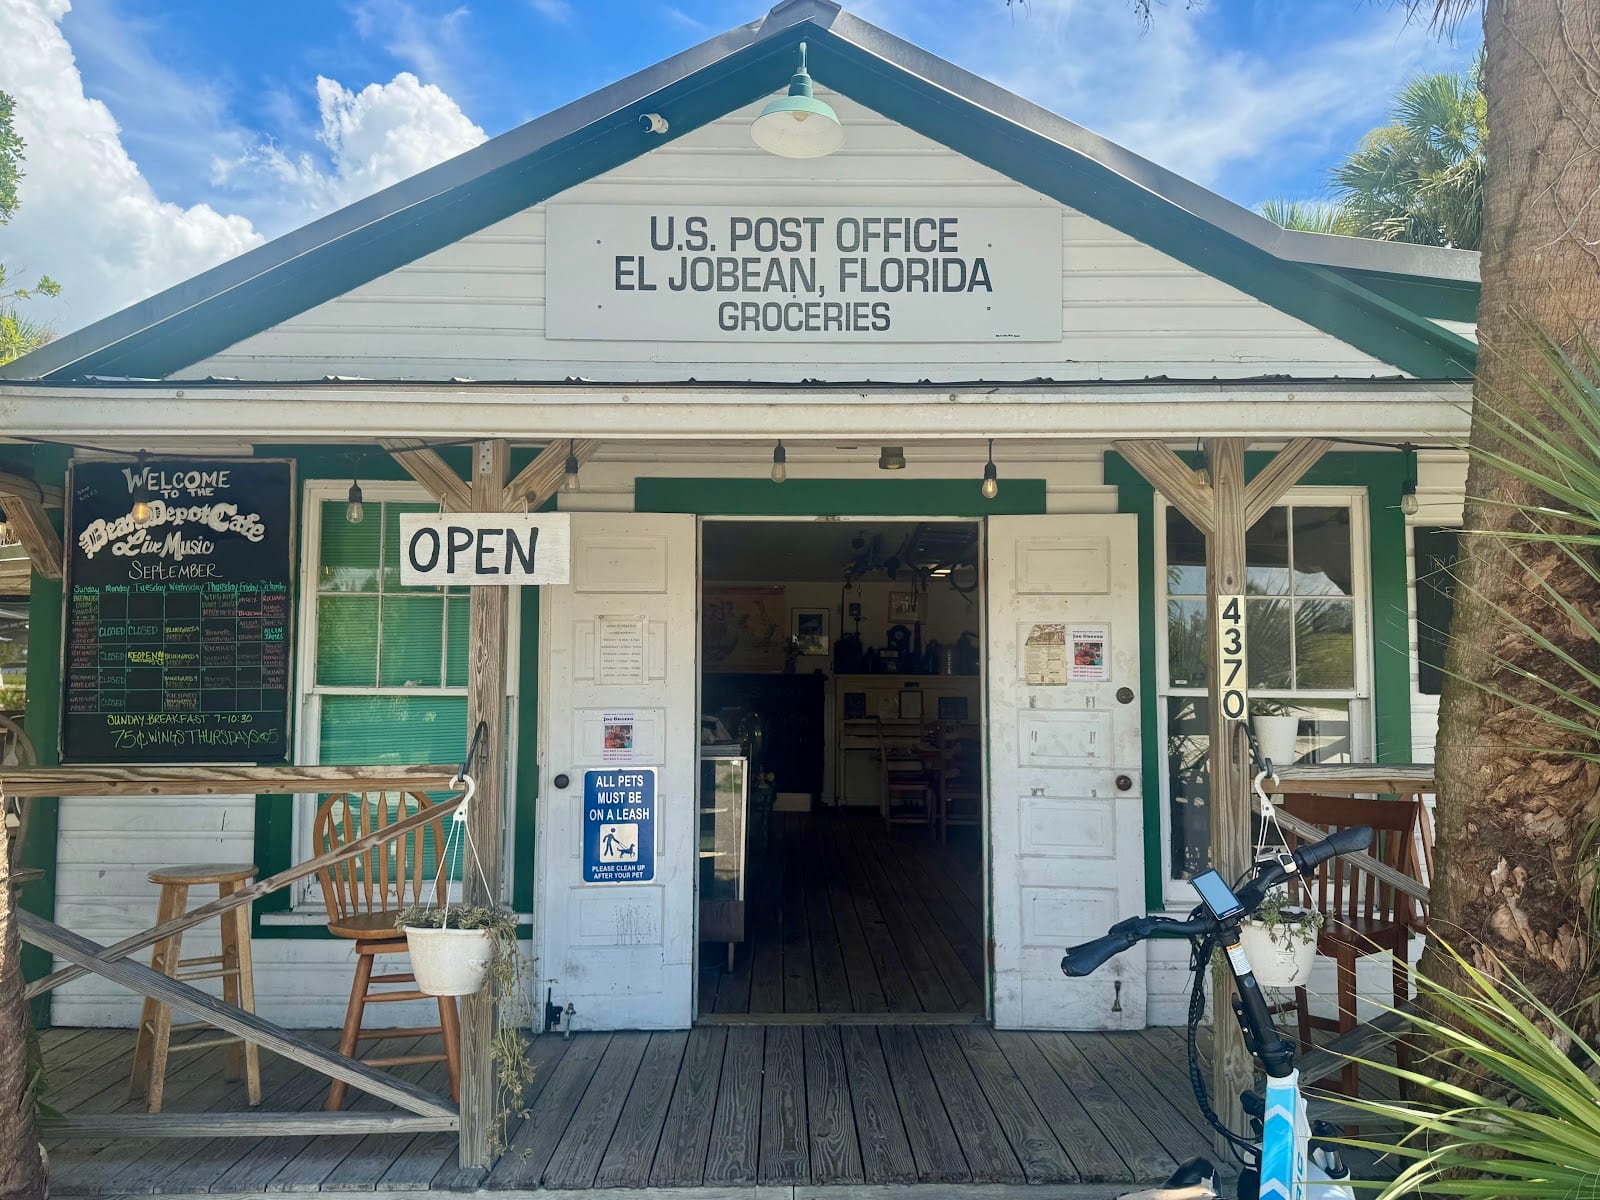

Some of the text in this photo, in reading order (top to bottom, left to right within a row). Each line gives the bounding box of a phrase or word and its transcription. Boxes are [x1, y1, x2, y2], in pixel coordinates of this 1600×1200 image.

[649, 216, 958, 252] U.S. POST OFFICE
[614, 255, 993, 298] EL JOBEAN, FLORIDA
[718, 302, 891, 332] GROCERIES
[121, 467, 231, 493] WELCOME
[160, 487, 214, 499] TO THE
[146, 500, 211, 527] Depot
[112, 529, 214, 561] Live Music
[408, 526, 539, 574] OPEN
[73, 584, 99, 594] Sunday
[133, 582, 166, 594] Tuesday
[205, 581, 238, 593] Thursday
[99, 627, 126, 637] CLOSED
[128, 625, 158, 635] CLOSED
[1222, 597, 1245, 718] 4370
[107, 714, 253, 727] SUNDAY BREAKFAST 7-10:30
[595, 775, 644, 788] ALL PETS
[597, 792, 642, 804] MUST BE
[589, 808, 649, 821] ON A LEASH
